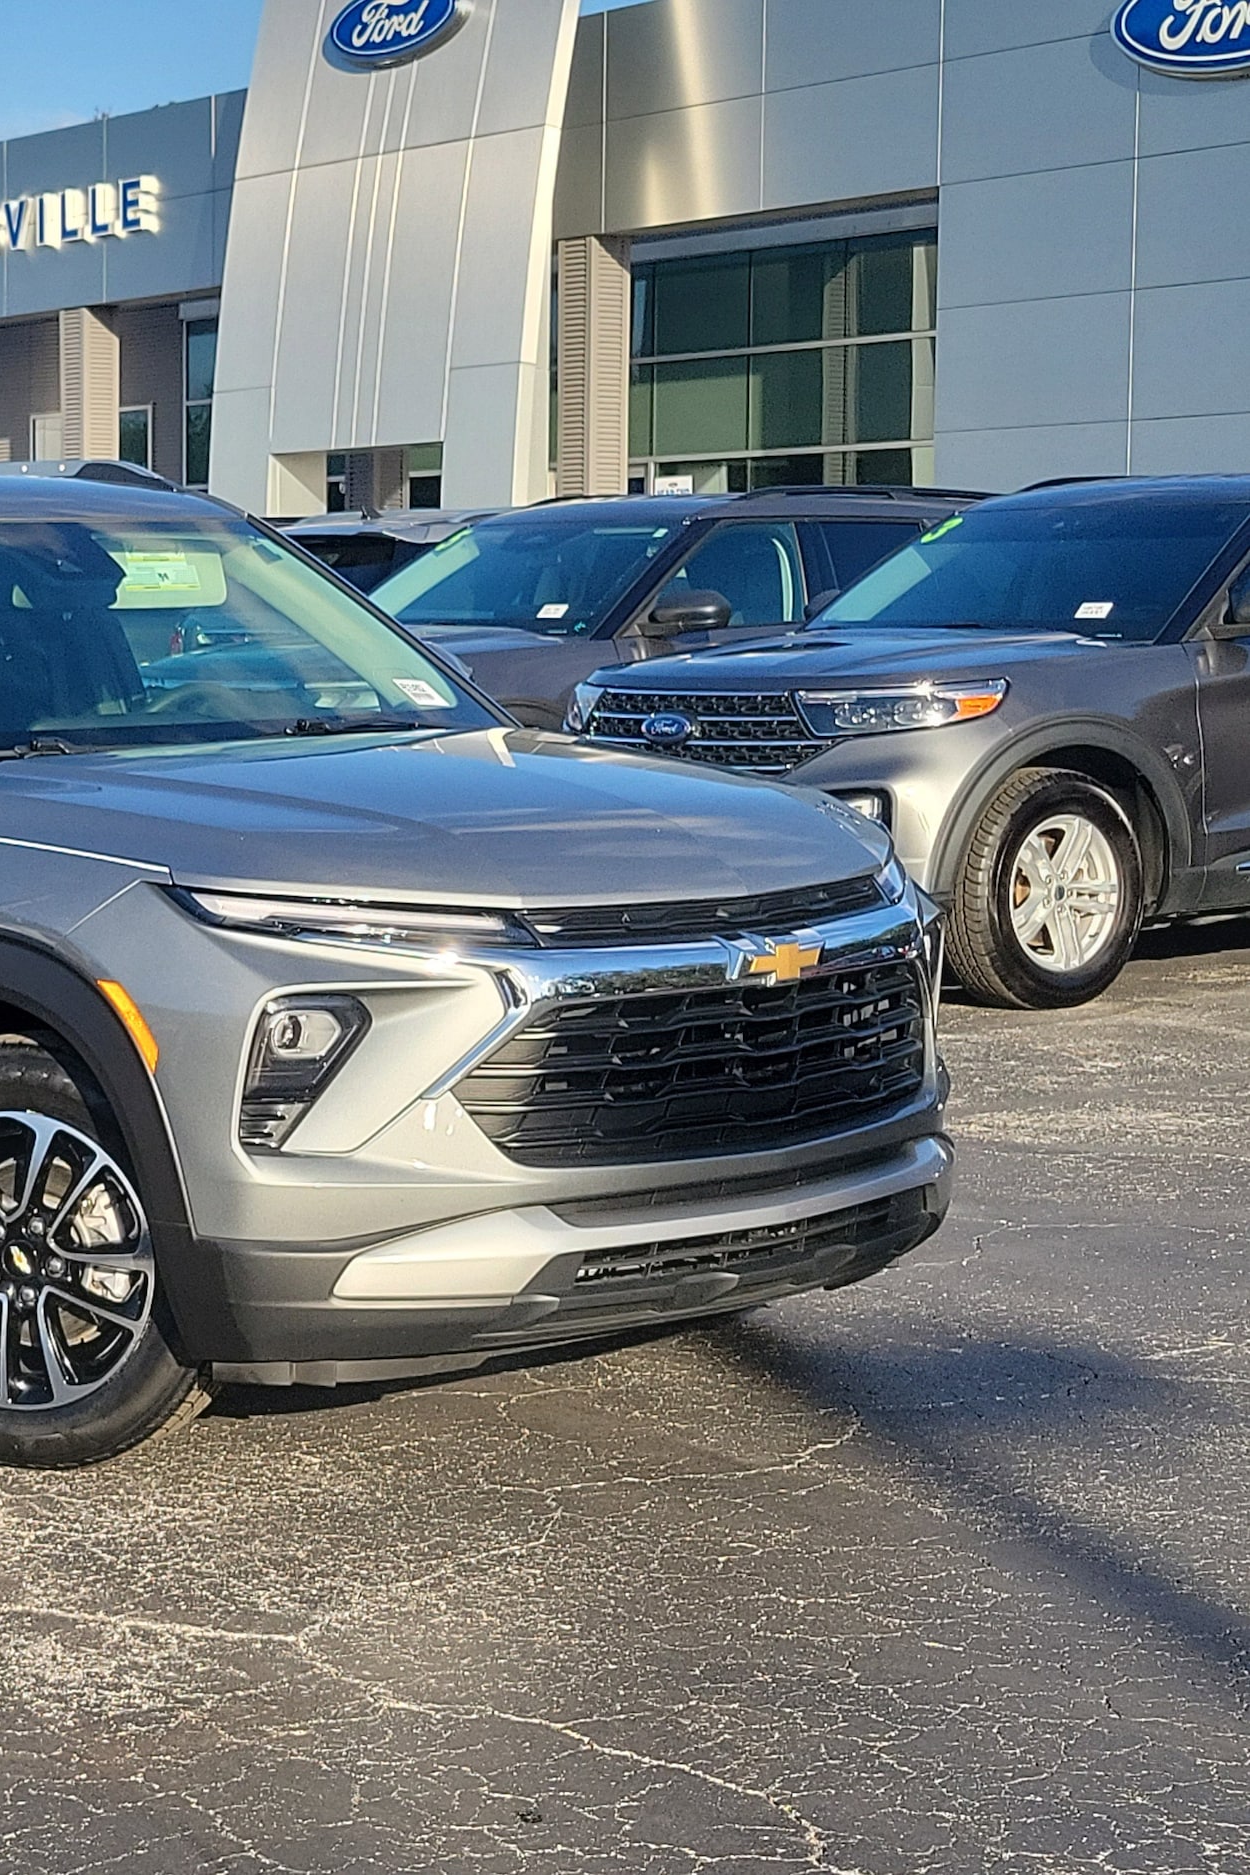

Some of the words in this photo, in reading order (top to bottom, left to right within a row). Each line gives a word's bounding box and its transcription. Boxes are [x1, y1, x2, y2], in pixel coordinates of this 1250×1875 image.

[352, 0, 430, 47] Ford
[1159, 0, 1250, 50] For
[651, 720, 678, 735] Ford
